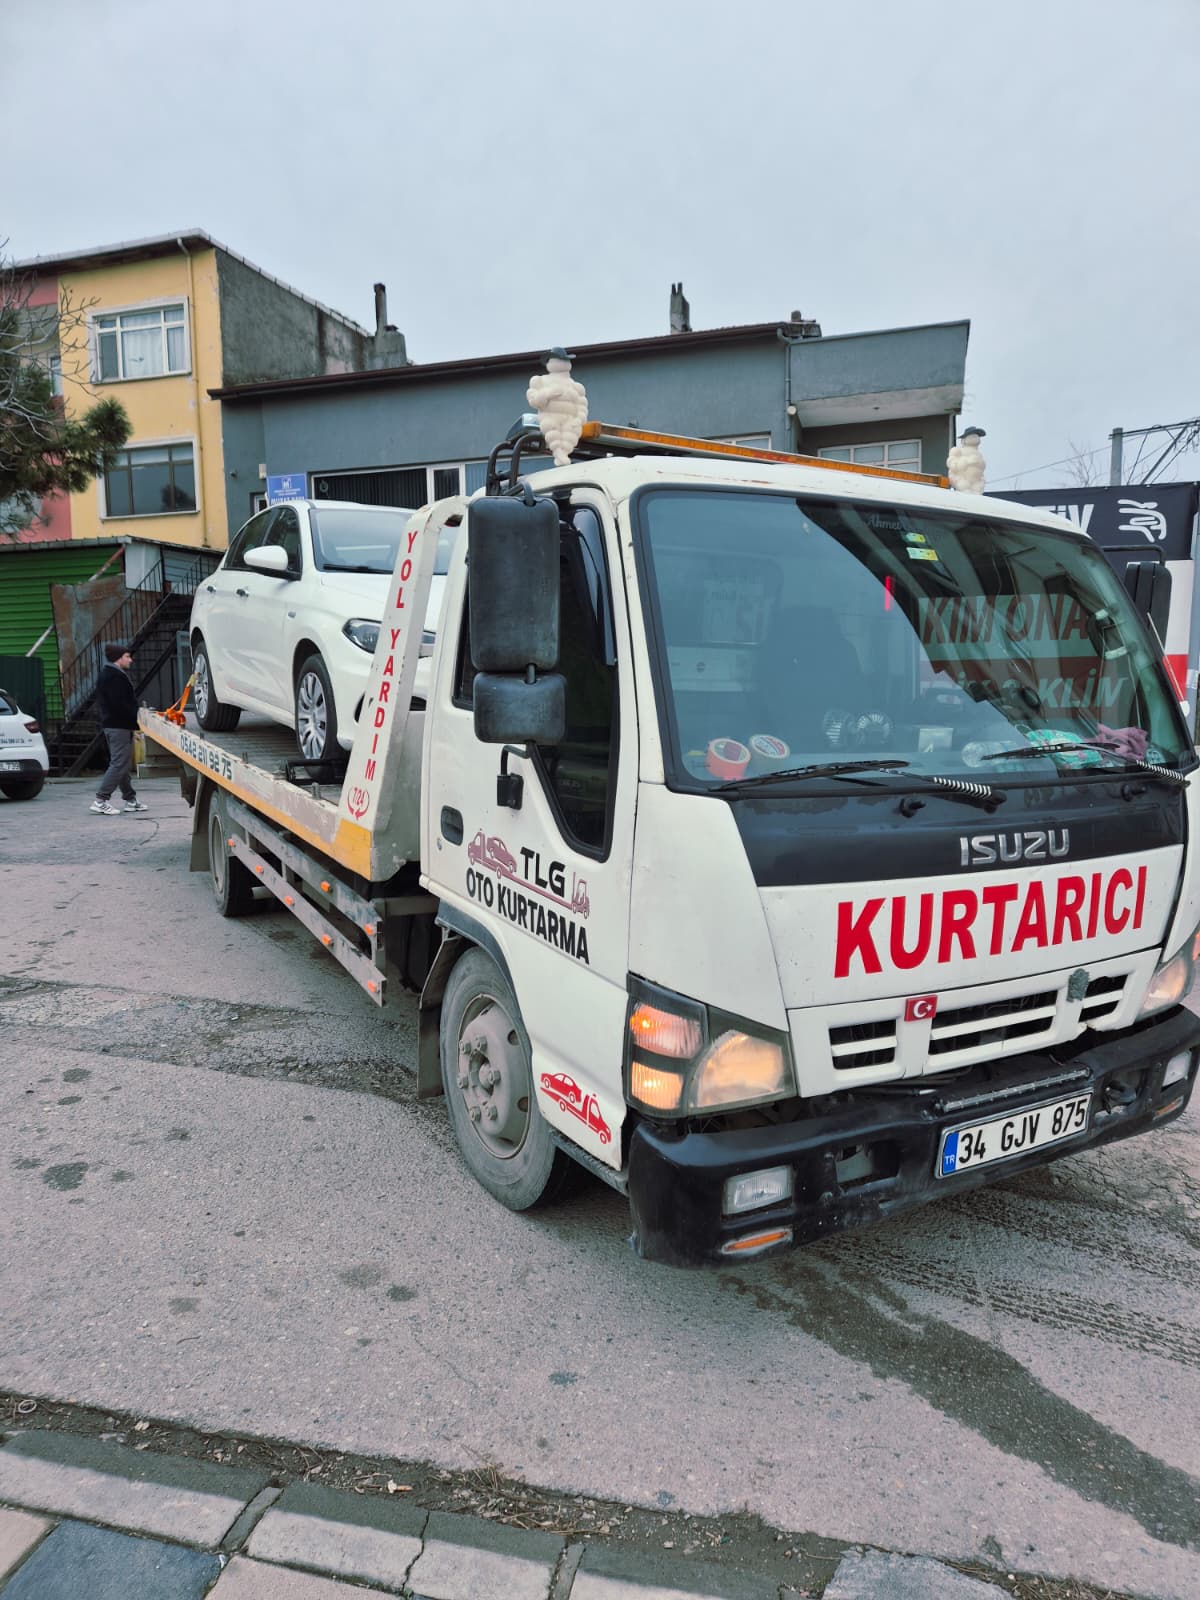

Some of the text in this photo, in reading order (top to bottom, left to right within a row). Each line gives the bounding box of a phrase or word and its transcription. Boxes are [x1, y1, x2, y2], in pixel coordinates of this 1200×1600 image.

[365, 530, 418, 782] YOL YARDIM
[209, 750, 220, 773] 92
[221, 757, 232, 781] 75
[519, 846, 566, 898] TLG
[960, 829, 1070, 867] ISUZU
[466, 867, 590, 965] OTO KURTARMA
[833, 865, 1148, 979] KURTARICI
[944, 1097, 1088, 1167] TR 34 GJV 875
